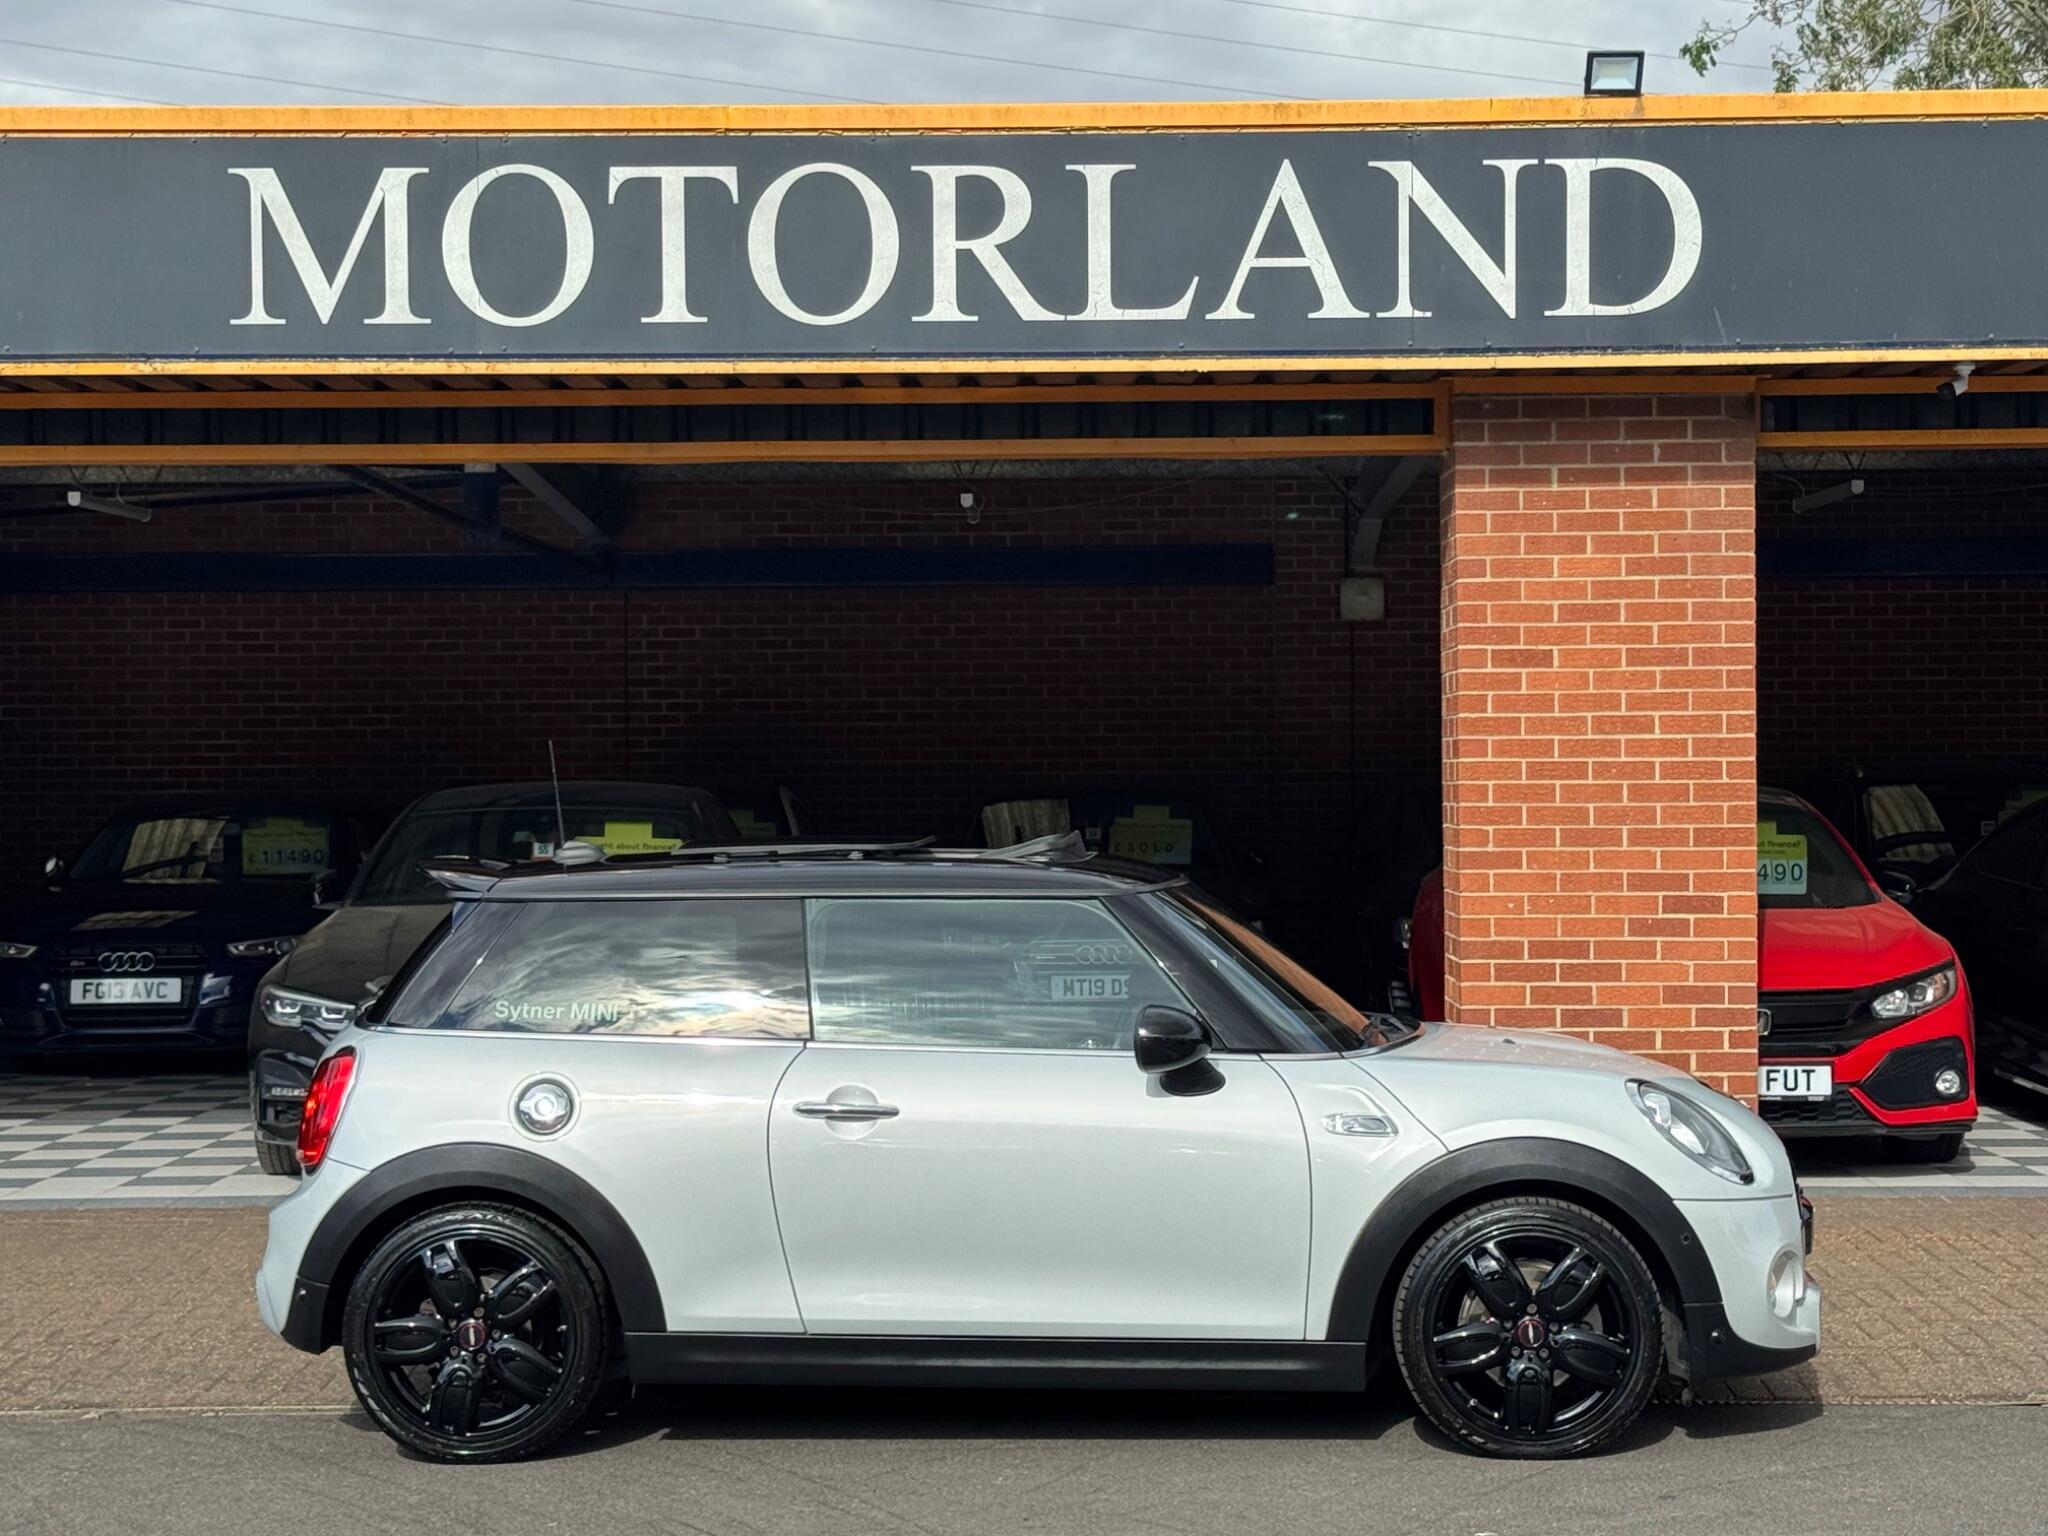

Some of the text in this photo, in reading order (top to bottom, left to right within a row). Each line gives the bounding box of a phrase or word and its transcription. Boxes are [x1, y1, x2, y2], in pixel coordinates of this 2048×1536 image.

[227, 158, 1703, 327] MOTORLAND
[82, 981, 168, 1000] FG13 AVC
[1063, 978, 1105, 997] MT19
[494, 1000, 619, 1022] Sytner MINI
[1766, 1069, 1816, 1092] FUT
